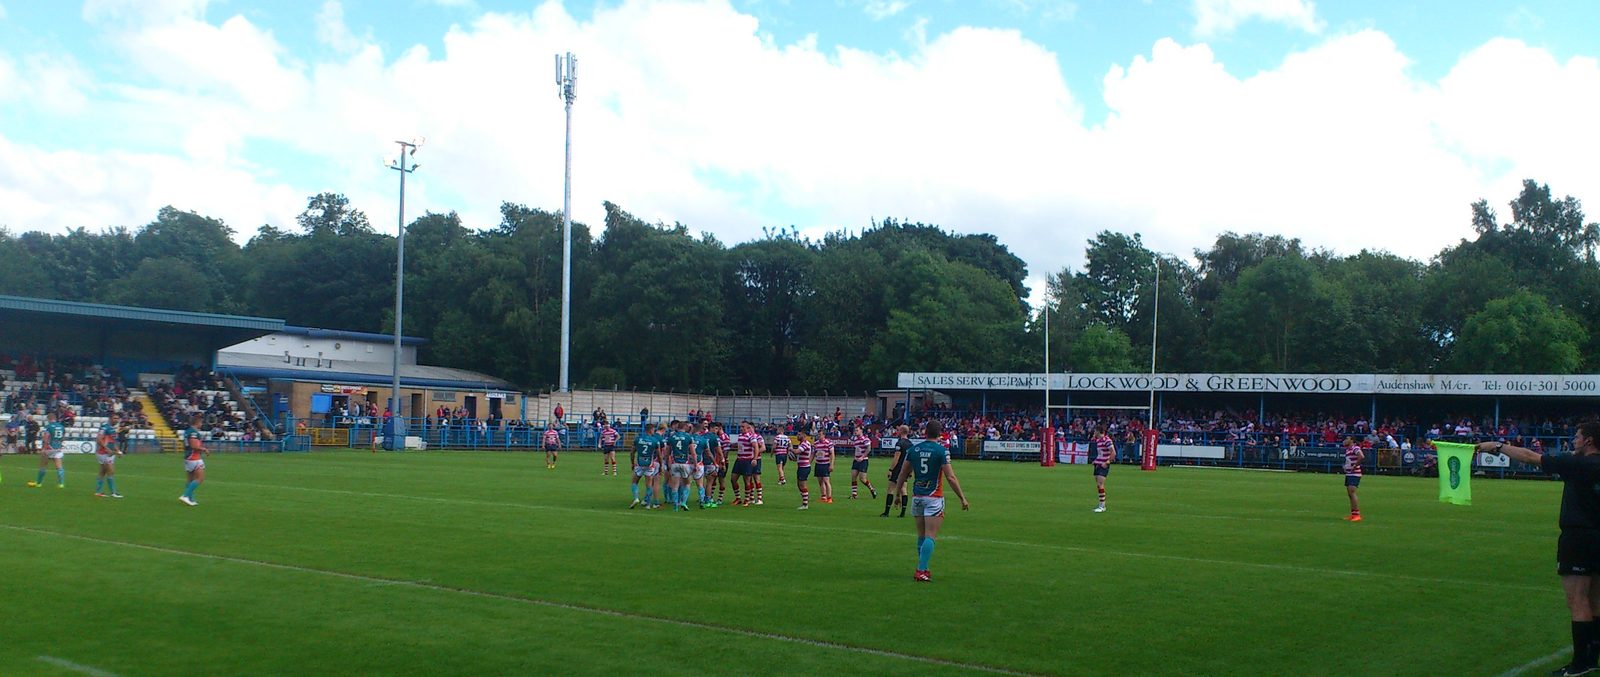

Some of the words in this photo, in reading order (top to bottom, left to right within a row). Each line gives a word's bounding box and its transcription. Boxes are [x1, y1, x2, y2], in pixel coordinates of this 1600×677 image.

[917, 375, 954, 385] SALES
[1068, 375, 1179, 389] LOCKWOOD
[1185, 377, 1200, 390] &
[1206, 375, 1352, 391] GREENWOOD
[1377, 379, 1436, 390] Audenshaw
[1482, 380, 1501, 391] Tel:
[1506, 380, 1558, 392] 0161-301
[1563, 380, 1596, 391] 5000
[676, 440, 683, 450] 4
[779, 439, 788, 447] 12
[641, 445, 648, 454] 2
[920, 457, 929, 474] 5
